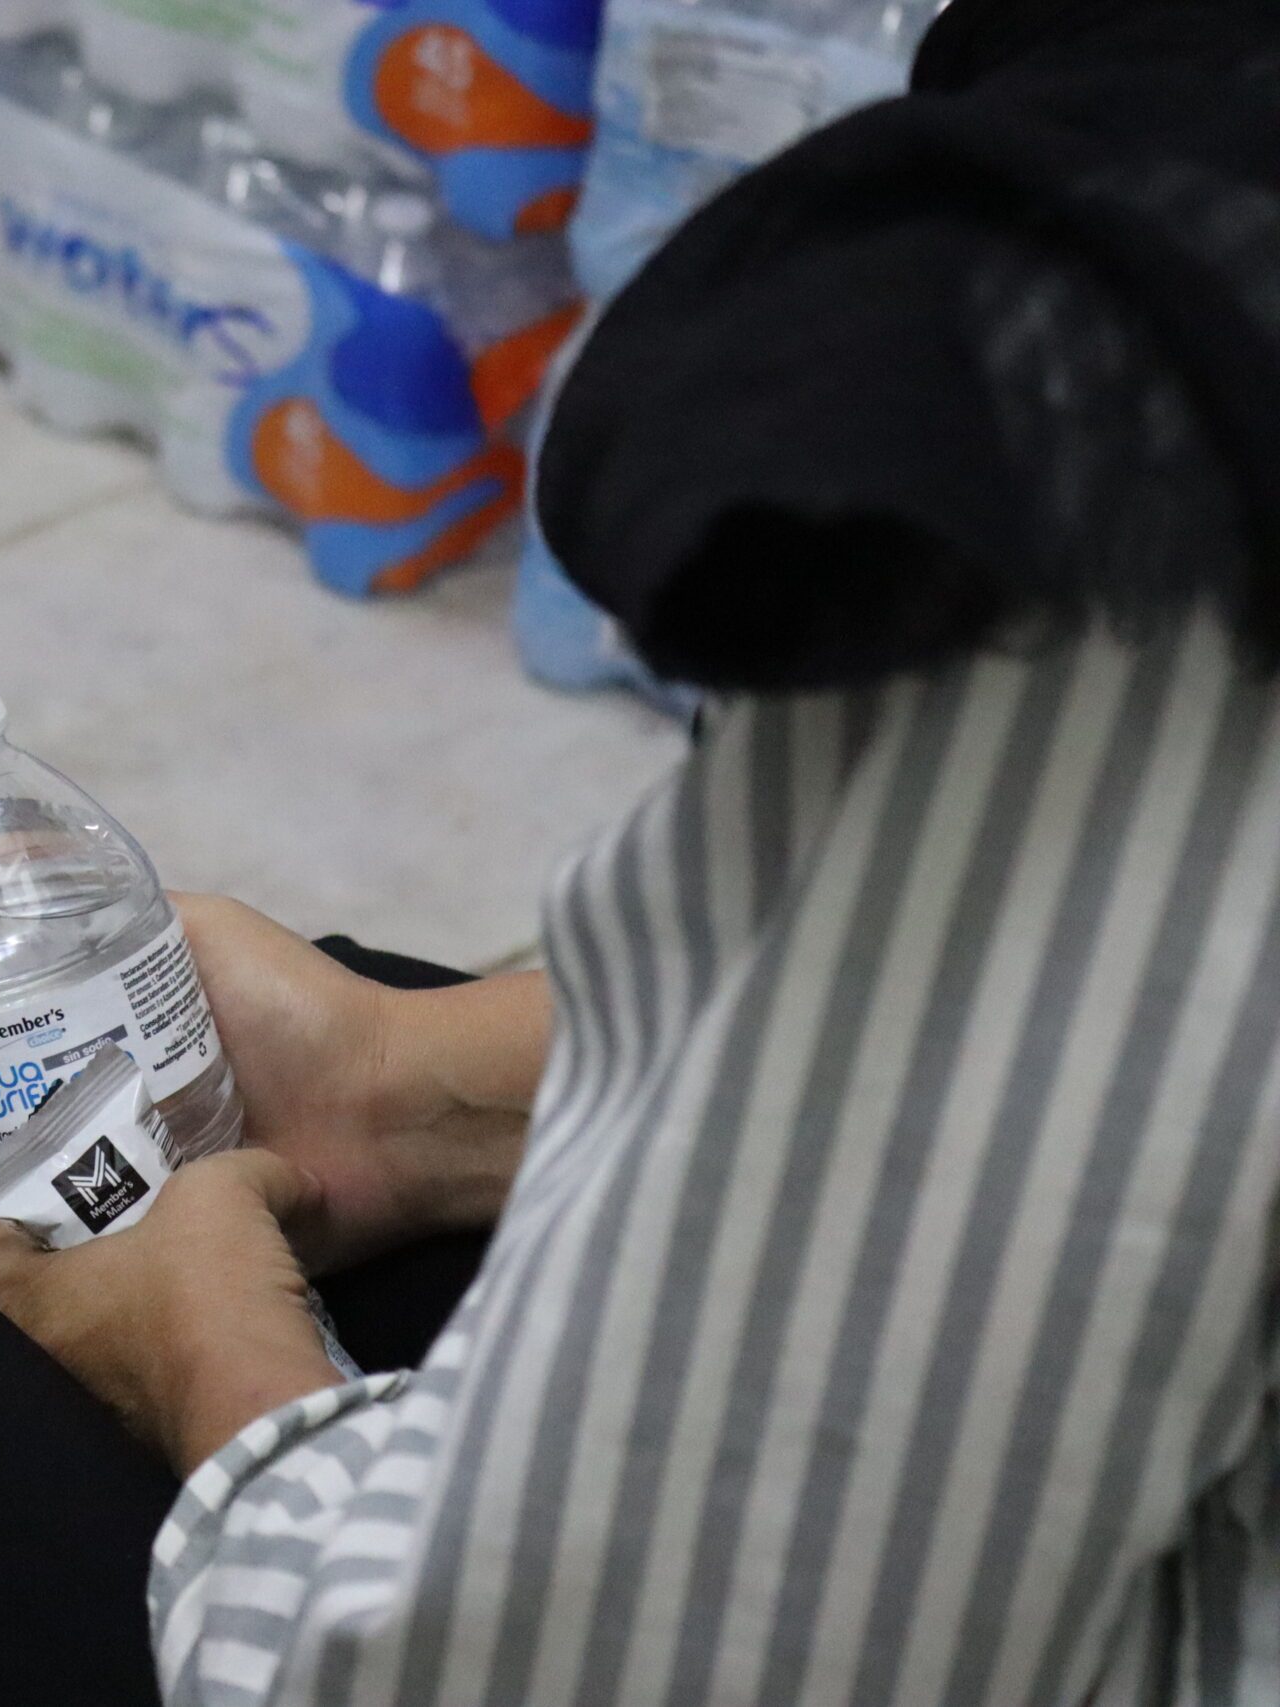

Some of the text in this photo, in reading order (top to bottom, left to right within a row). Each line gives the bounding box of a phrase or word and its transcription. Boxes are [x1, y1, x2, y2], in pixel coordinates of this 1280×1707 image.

[140, 1012, 166, 1033] Consulta
[164, 1036, 188, 1056] Producto
[62, 1050, 81, 1064] sin
[89, 1181, 134, 1219] Member's
